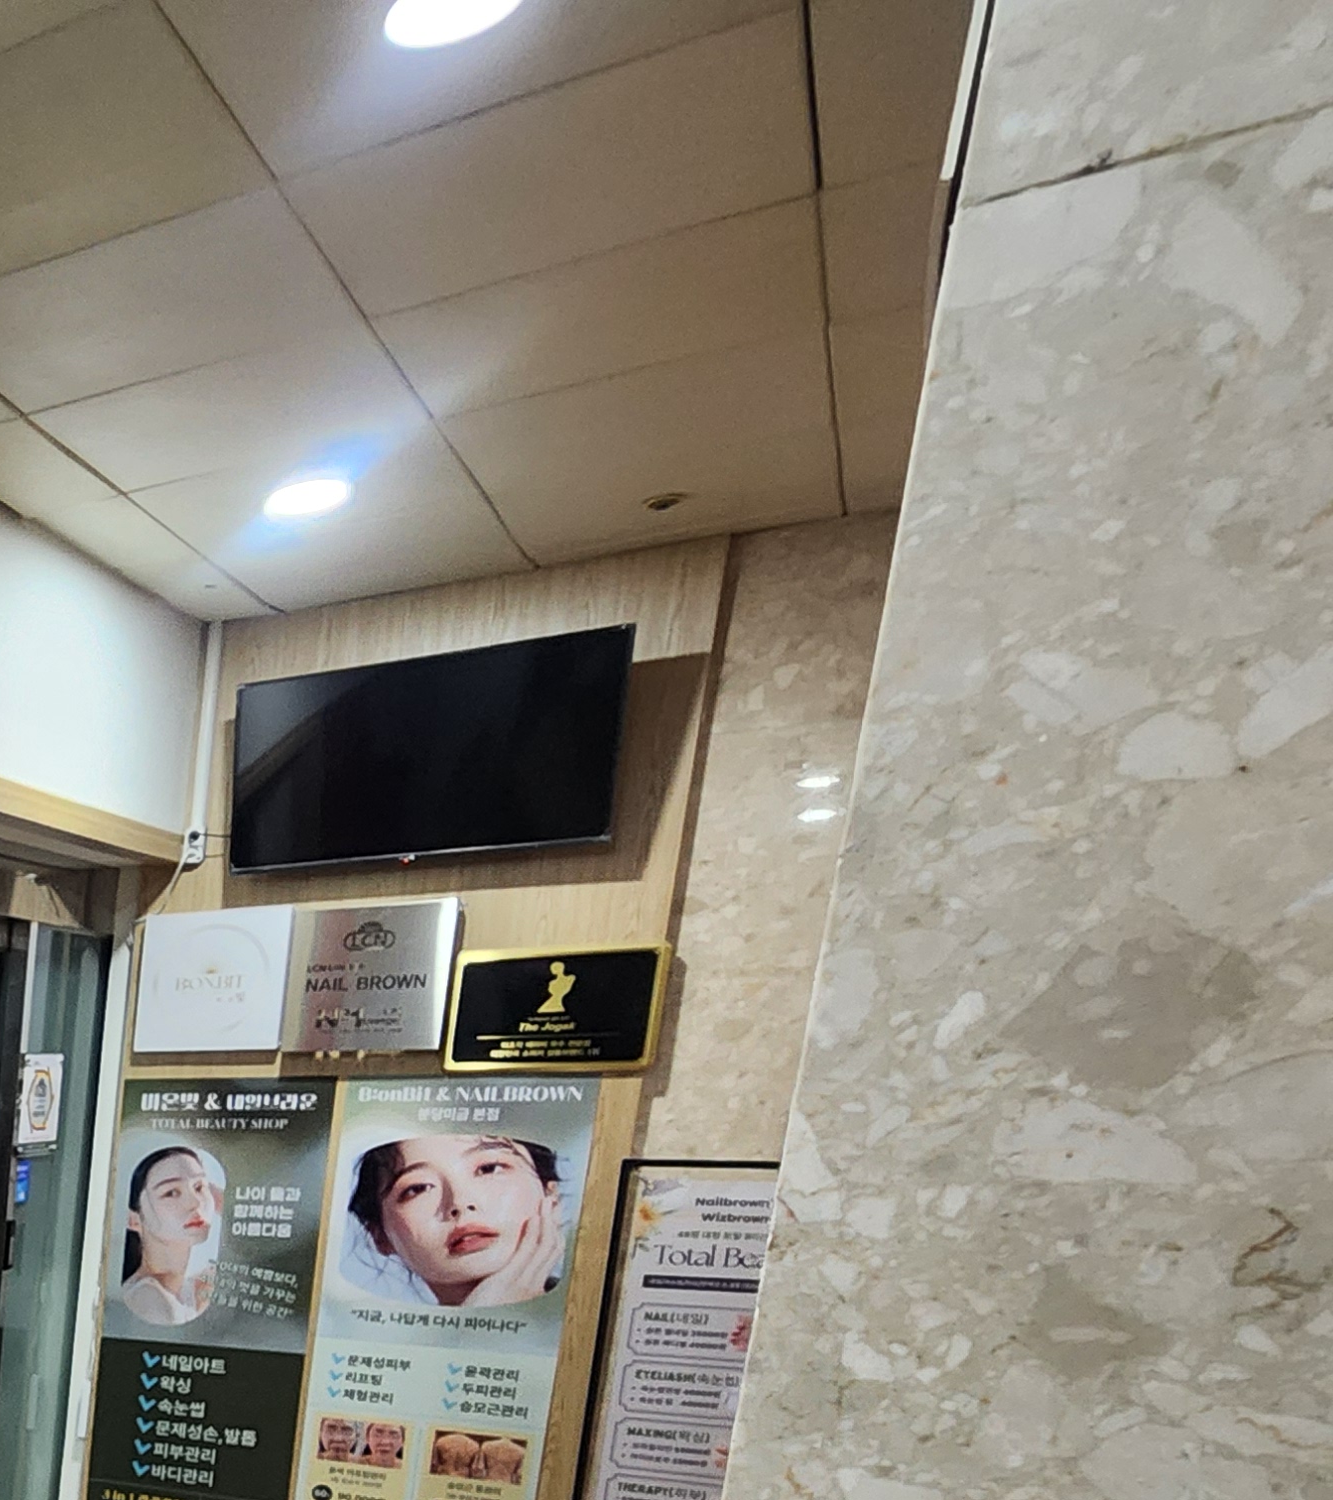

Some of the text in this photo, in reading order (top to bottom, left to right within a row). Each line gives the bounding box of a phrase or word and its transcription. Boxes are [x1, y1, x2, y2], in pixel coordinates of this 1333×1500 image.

[350, 933, 388, 948] LCN
[305, 973, 427, 993] NAIL BROWN
[203, 1092, 222, 1111] &
[436, 1085, 451, 1102] &
[150, 1116, 289, 1130] TOTAL BEAUTY SHOP
[235, 1186, 265, 1201] 나이
[653, 1243, 717, 1268] Total
[433, 1313, 460, 1330] 다시
[162, 1354, 226, 1375] 네일아트
[347, 1354, 412, 1372] 문제성피부
[159, 1375, 192, 1394] 왁싱
[157, 1398, 206, 1418] 속눈썹
[153, 1442, 216, 1465] 피부관리
[150, 1464, 214, 1488] 바디관리
